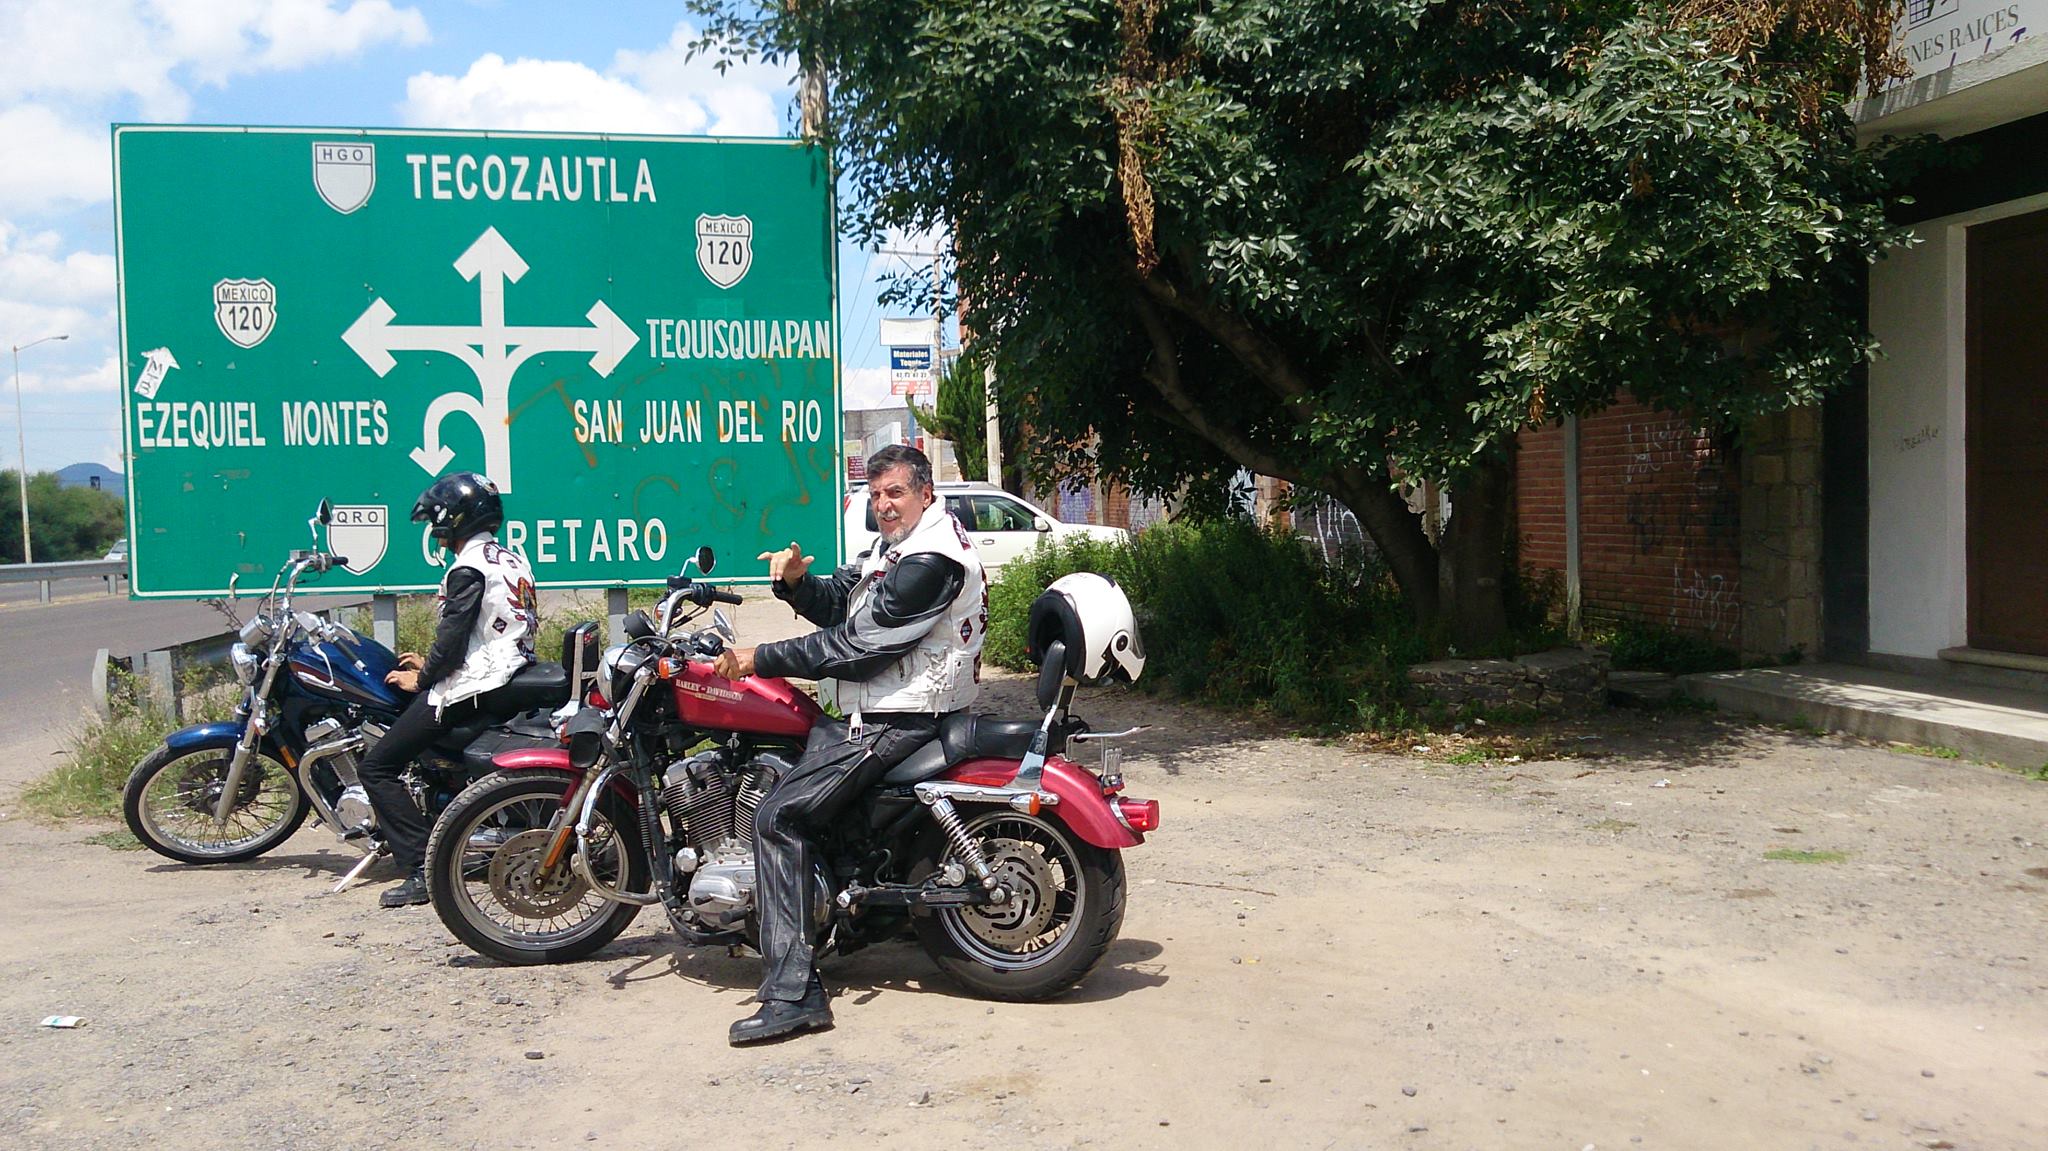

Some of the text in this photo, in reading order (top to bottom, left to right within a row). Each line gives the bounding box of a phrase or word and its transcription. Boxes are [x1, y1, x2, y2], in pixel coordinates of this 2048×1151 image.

[1949, 4, 2019, 50] RAICES
[322, 148, 363, 161] HGO
[406, 154, 657, 203] TECOZAUTLA
[705, 223, 743, 234] MEXICO
[707, 240, 743, 266] 120
[221, 287, 268, 301] MEXICO
[228, 305, 263, 331] 120
[646, 318, 831, 360] TEQUISQUIAPAN
[137, 401, 389, 449] EZEQUIEL MONTES
[574, 399, 822, 444] SAN JUAN DEL RIO
[336, 510, 379, 524] QRO
[422, 516, 668, 568] QRETARO
